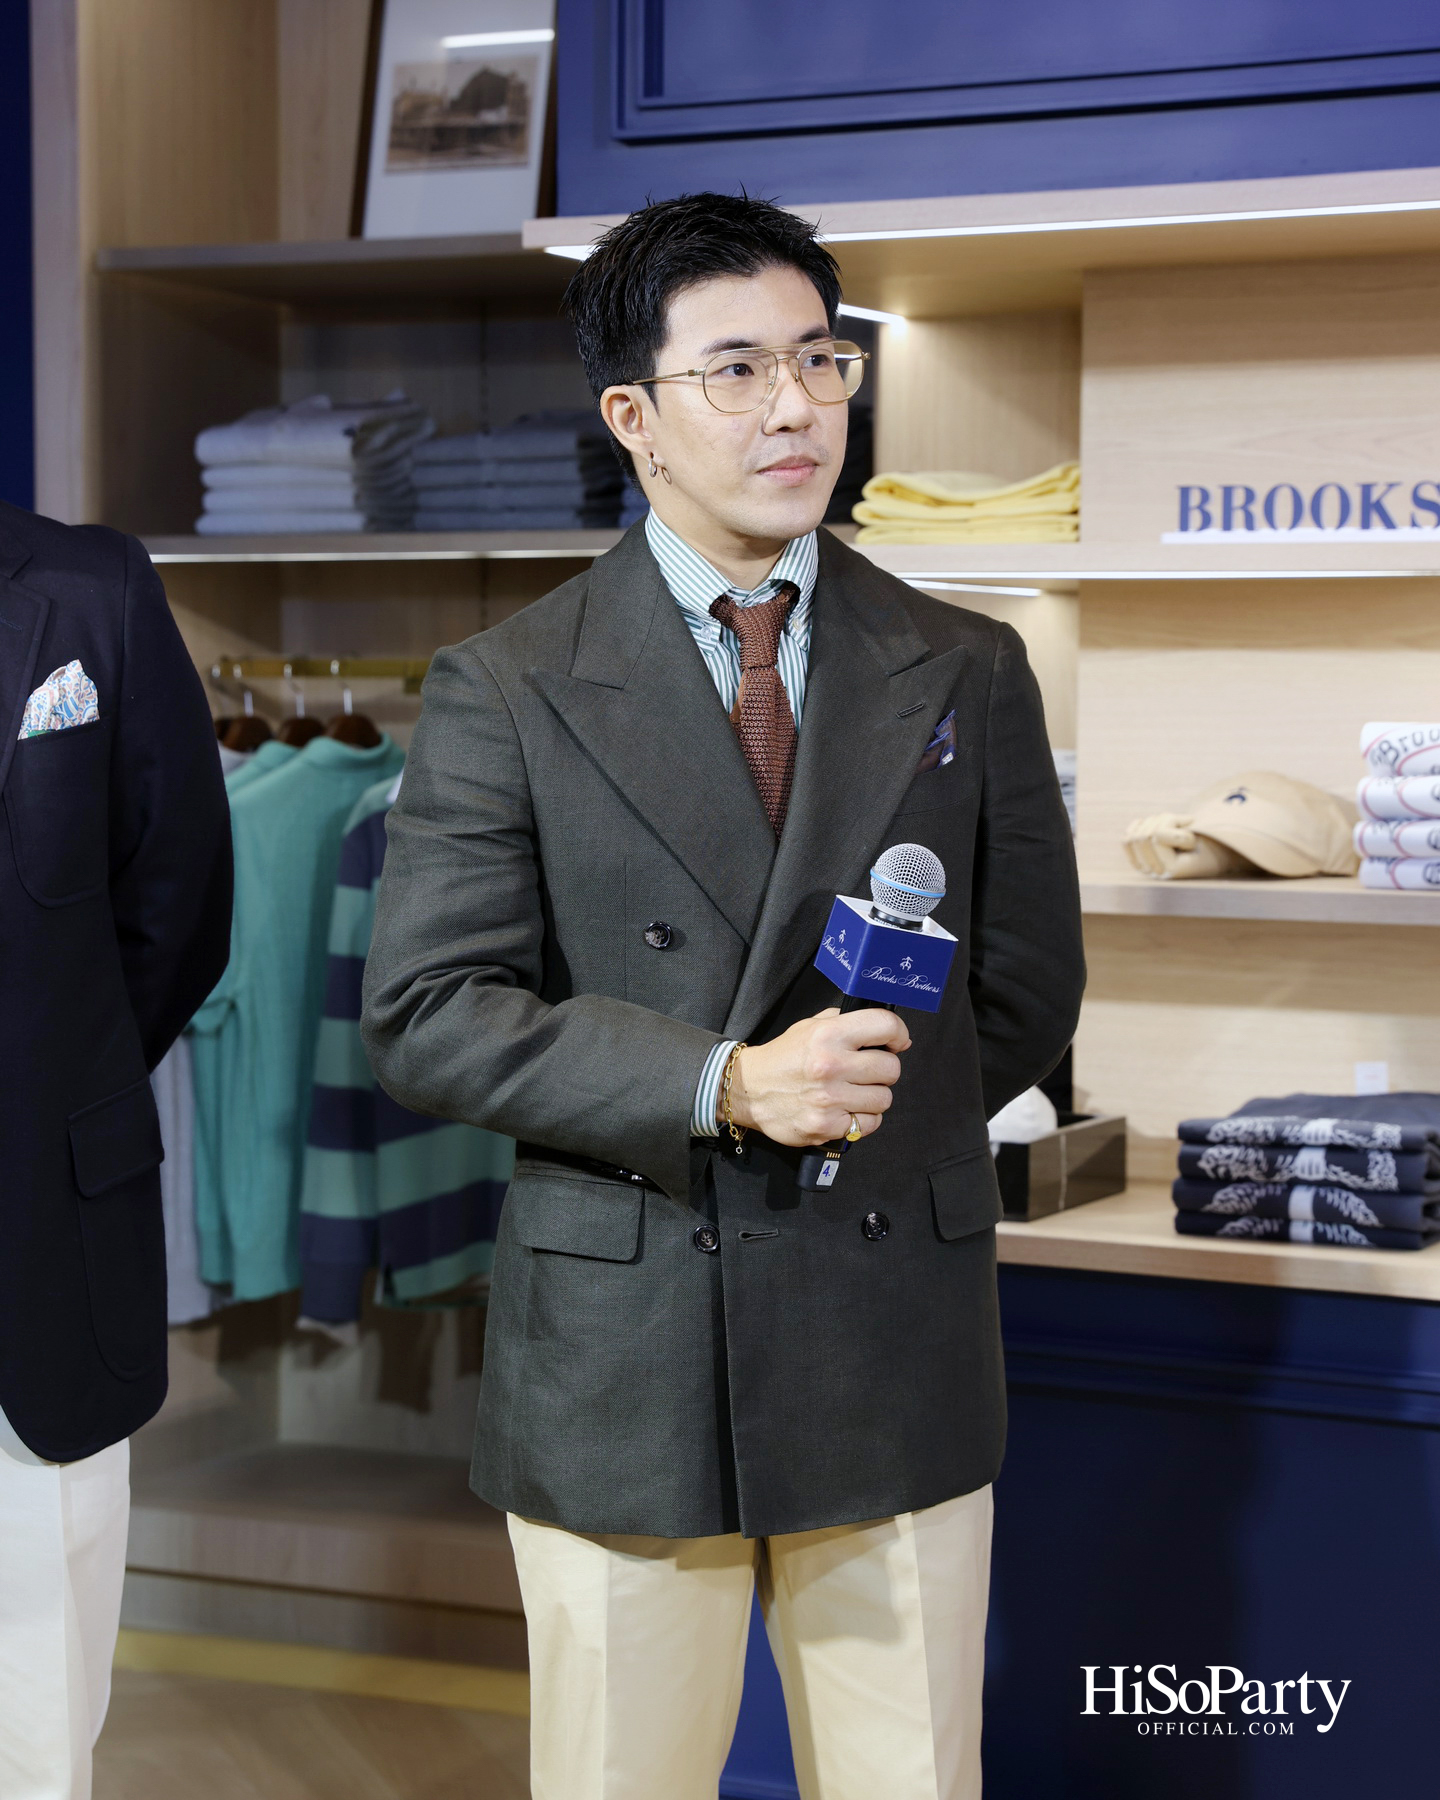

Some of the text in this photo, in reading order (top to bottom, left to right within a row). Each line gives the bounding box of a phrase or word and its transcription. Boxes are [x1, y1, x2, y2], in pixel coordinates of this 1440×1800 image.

[1176, 481, 1440, 532] BROOKS
[861, 966, 941, 993] Brooks Brothers
